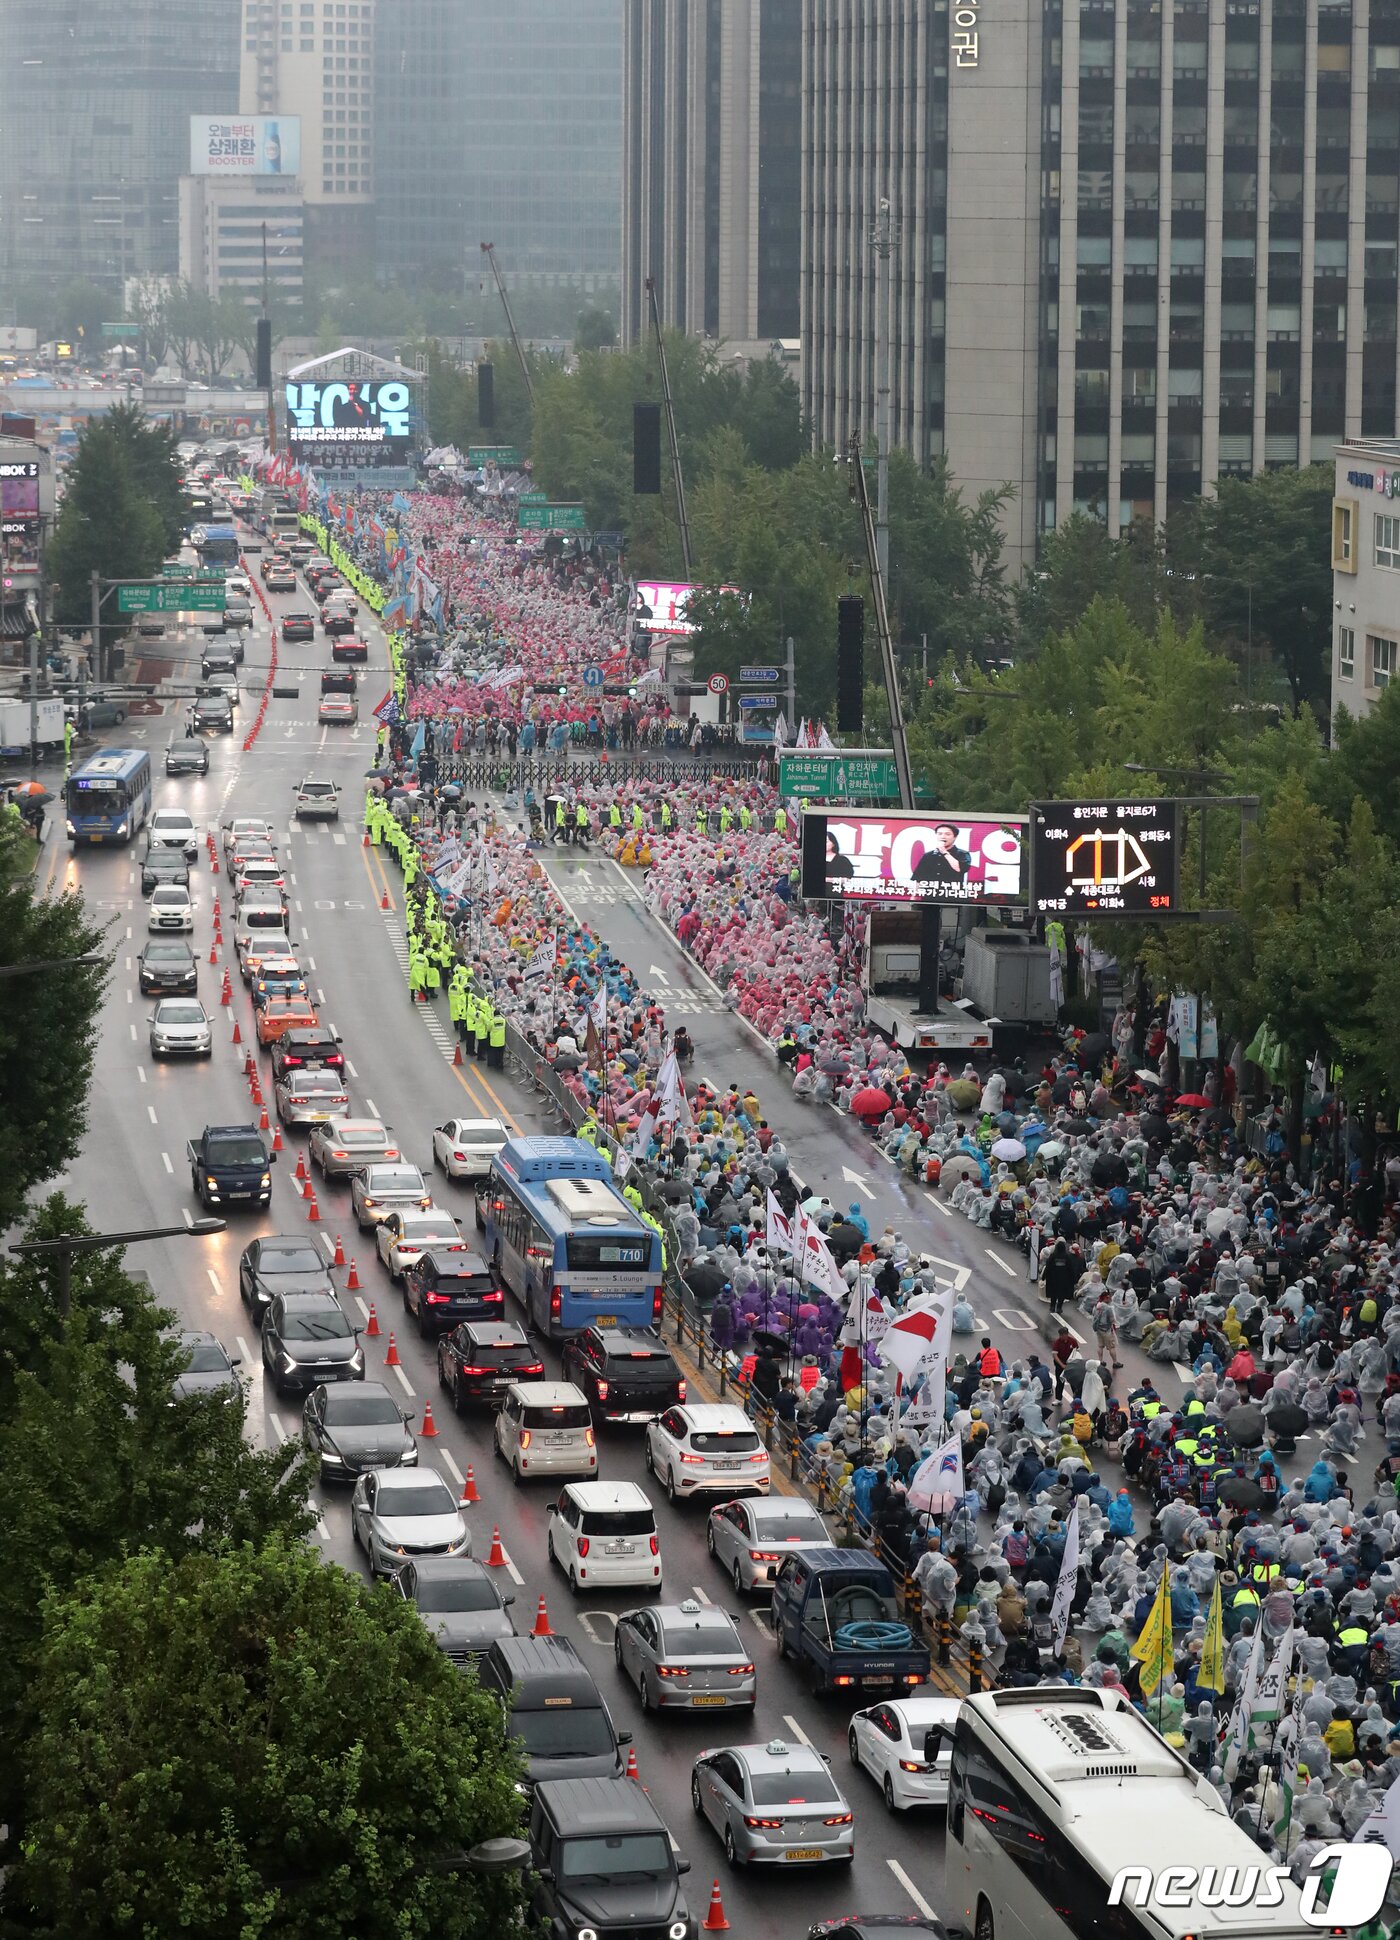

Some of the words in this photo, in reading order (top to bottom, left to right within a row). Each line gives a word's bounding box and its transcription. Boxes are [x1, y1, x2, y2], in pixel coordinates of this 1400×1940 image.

[208, 124, 255, 137] 오늘부터
[208, 138, 256, 156] 상쾌환
[208, 157, 256, 166] BOOSTER
[712, 679, 725, 689] 50
[786, 763, 828, 773] 자하문터널
[848, 762, 878, 772] 흥인지문
[848, 779, 869, 789] 광화문
[1073, 806, 1109, 818] 흥인지문
[1116, 805, 1157, 818] 을지로6가
[1045, 828, 1069, 840] 이화4
[919, 880, 939, 889] 오래
[941, 881, 961, 890] 누릴
[963, 882, 983, 891] 세상
[1138, 875, 1156, 888] 시청
[832, 885, 842, 893] 자
[844, 885, 874, 894] 우리와
[876, 886, 906, 895] 싸우자
[907, 888, 937, 897] 자유가
[939, 889, 979, 899] 기다린다
[1080, 885, 1121, 896] 세종대로4
[1037, 898, 1068, 910] 창덕궁
[1099, 897, 1125, 909] 이화4
[1150, 895, 1171, 907] 정체
[622, 1250, 641, 1260] 710
